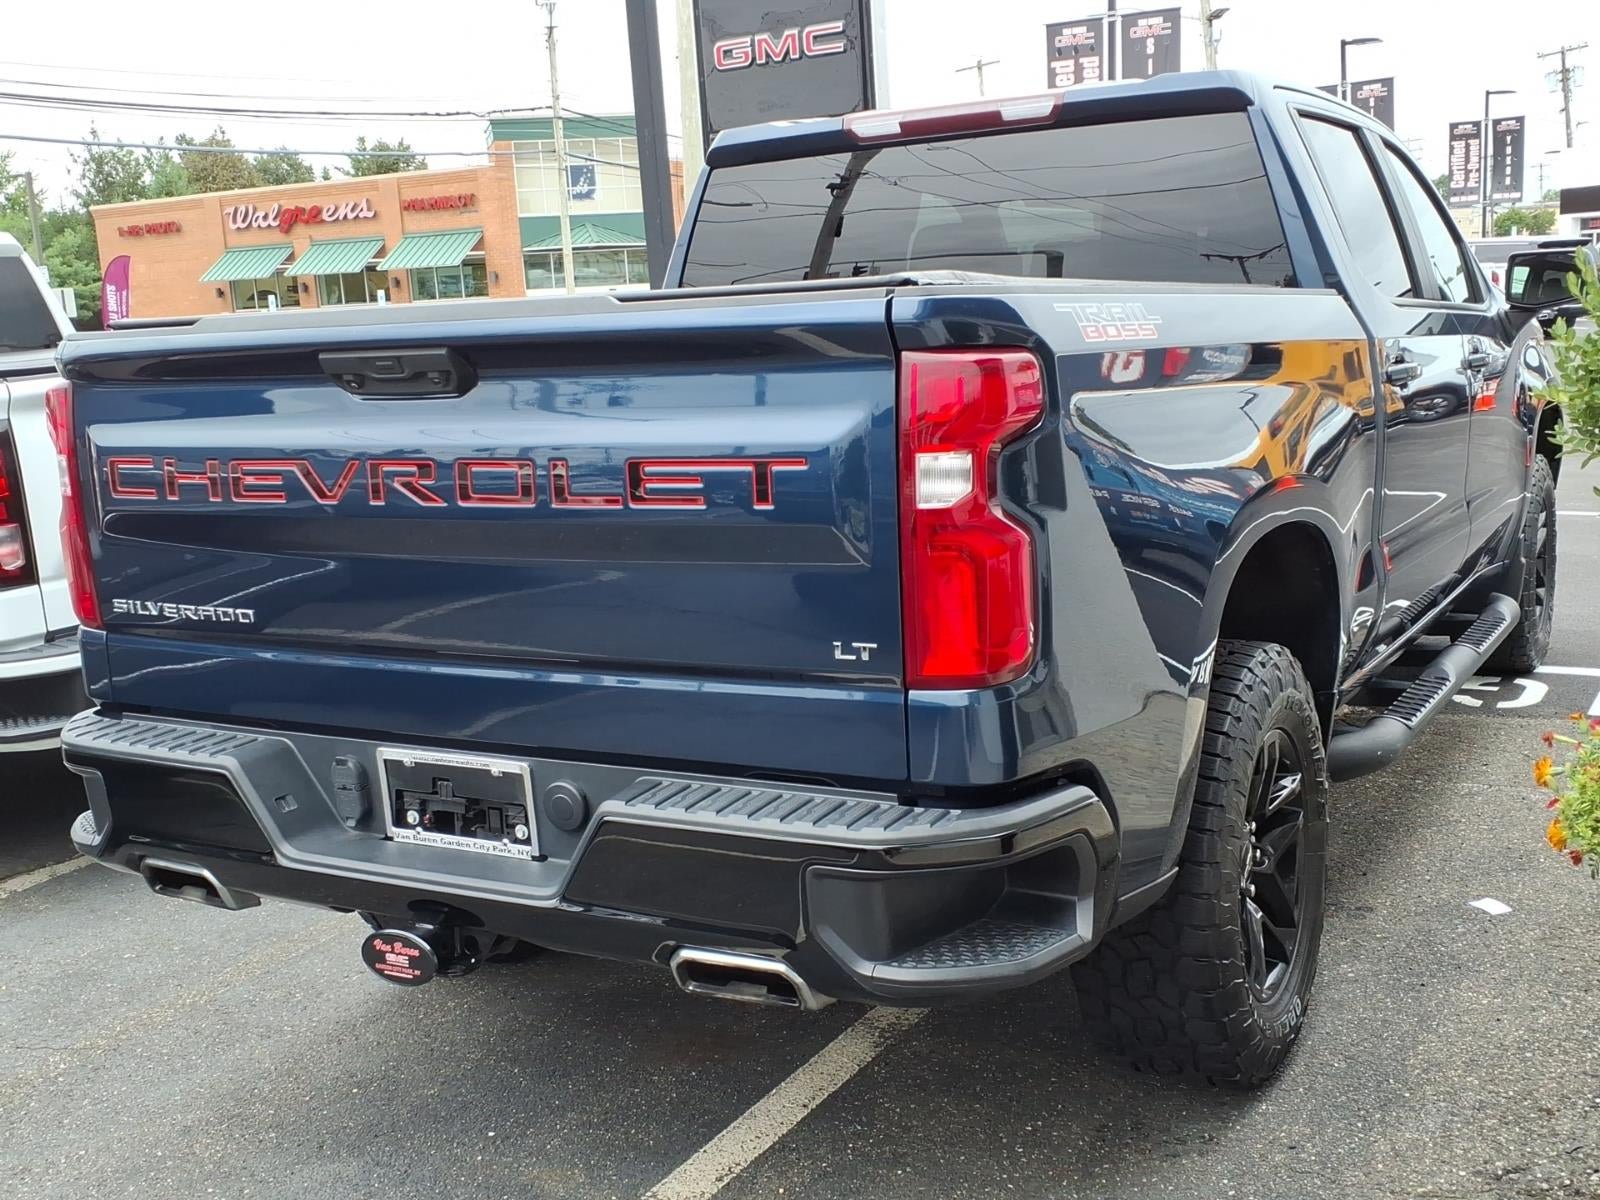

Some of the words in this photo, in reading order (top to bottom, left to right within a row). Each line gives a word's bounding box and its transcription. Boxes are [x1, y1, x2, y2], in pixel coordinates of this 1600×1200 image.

[714, 20, 846, 70] GMC
[1450, 140, 1466, 188] Certified
[1467, 139, 1480, 188] Pre-Owned
[224, 198, 376, 235] Walgreens
[1053, 303, 1162, 323] TRAIL
[1079, 323, 1158, 342] BOSS
[107, 457, 808, 511] CHEVROLET
[112, 599, 255, 623] SILVERADO
[833, 641, 877, 661] LT
[394, 832, 411, 841] Van
[413, 835, 438, 844] Buren
[440, 837, 471, 848] Garden
[473, 842, 490, 853] City
[517, 849, 530, 857] NY
[373, 939, 391, 951] Van
